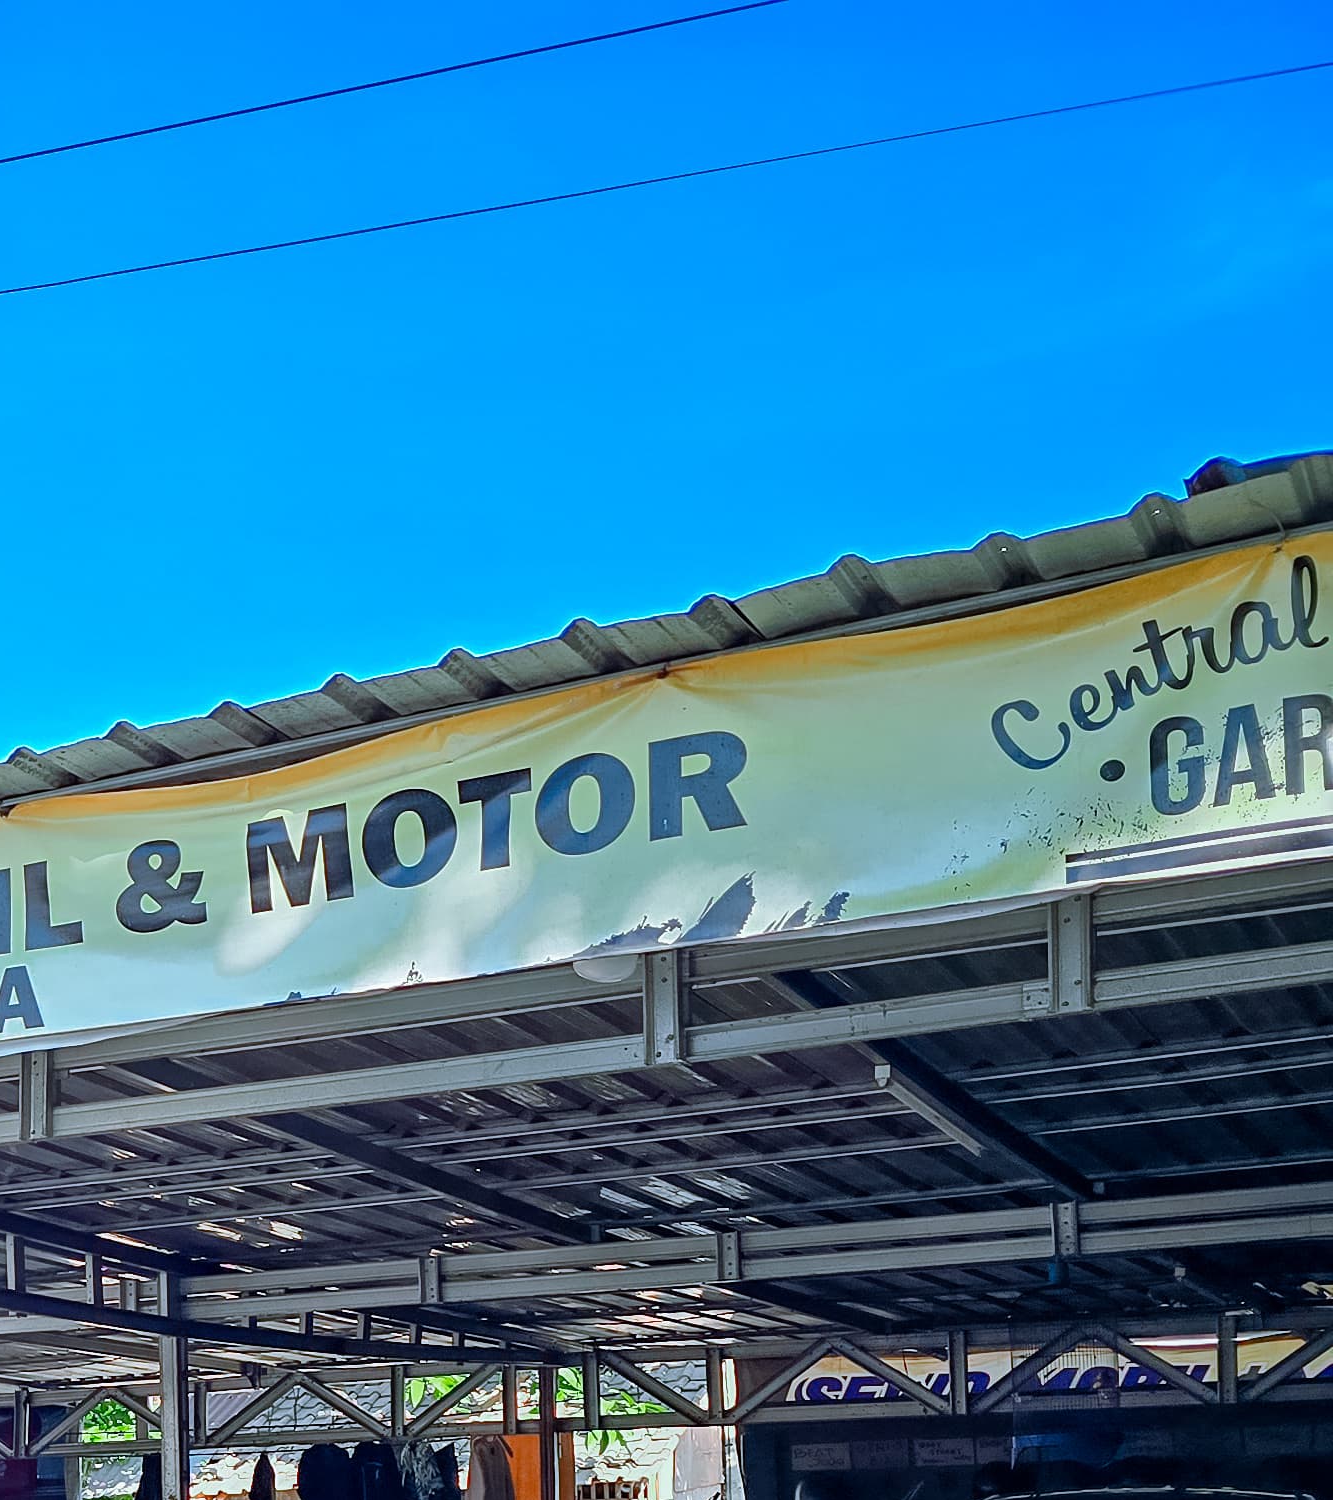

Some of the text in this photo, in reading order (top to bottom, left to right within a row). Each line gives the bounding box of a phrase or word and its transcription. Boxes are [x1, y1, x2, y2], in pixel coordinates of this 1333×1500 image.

[991, 555, 1330, 770] Central
[115, 838, 208, 933] &
[246, 730, 748, 914] MOTOR
